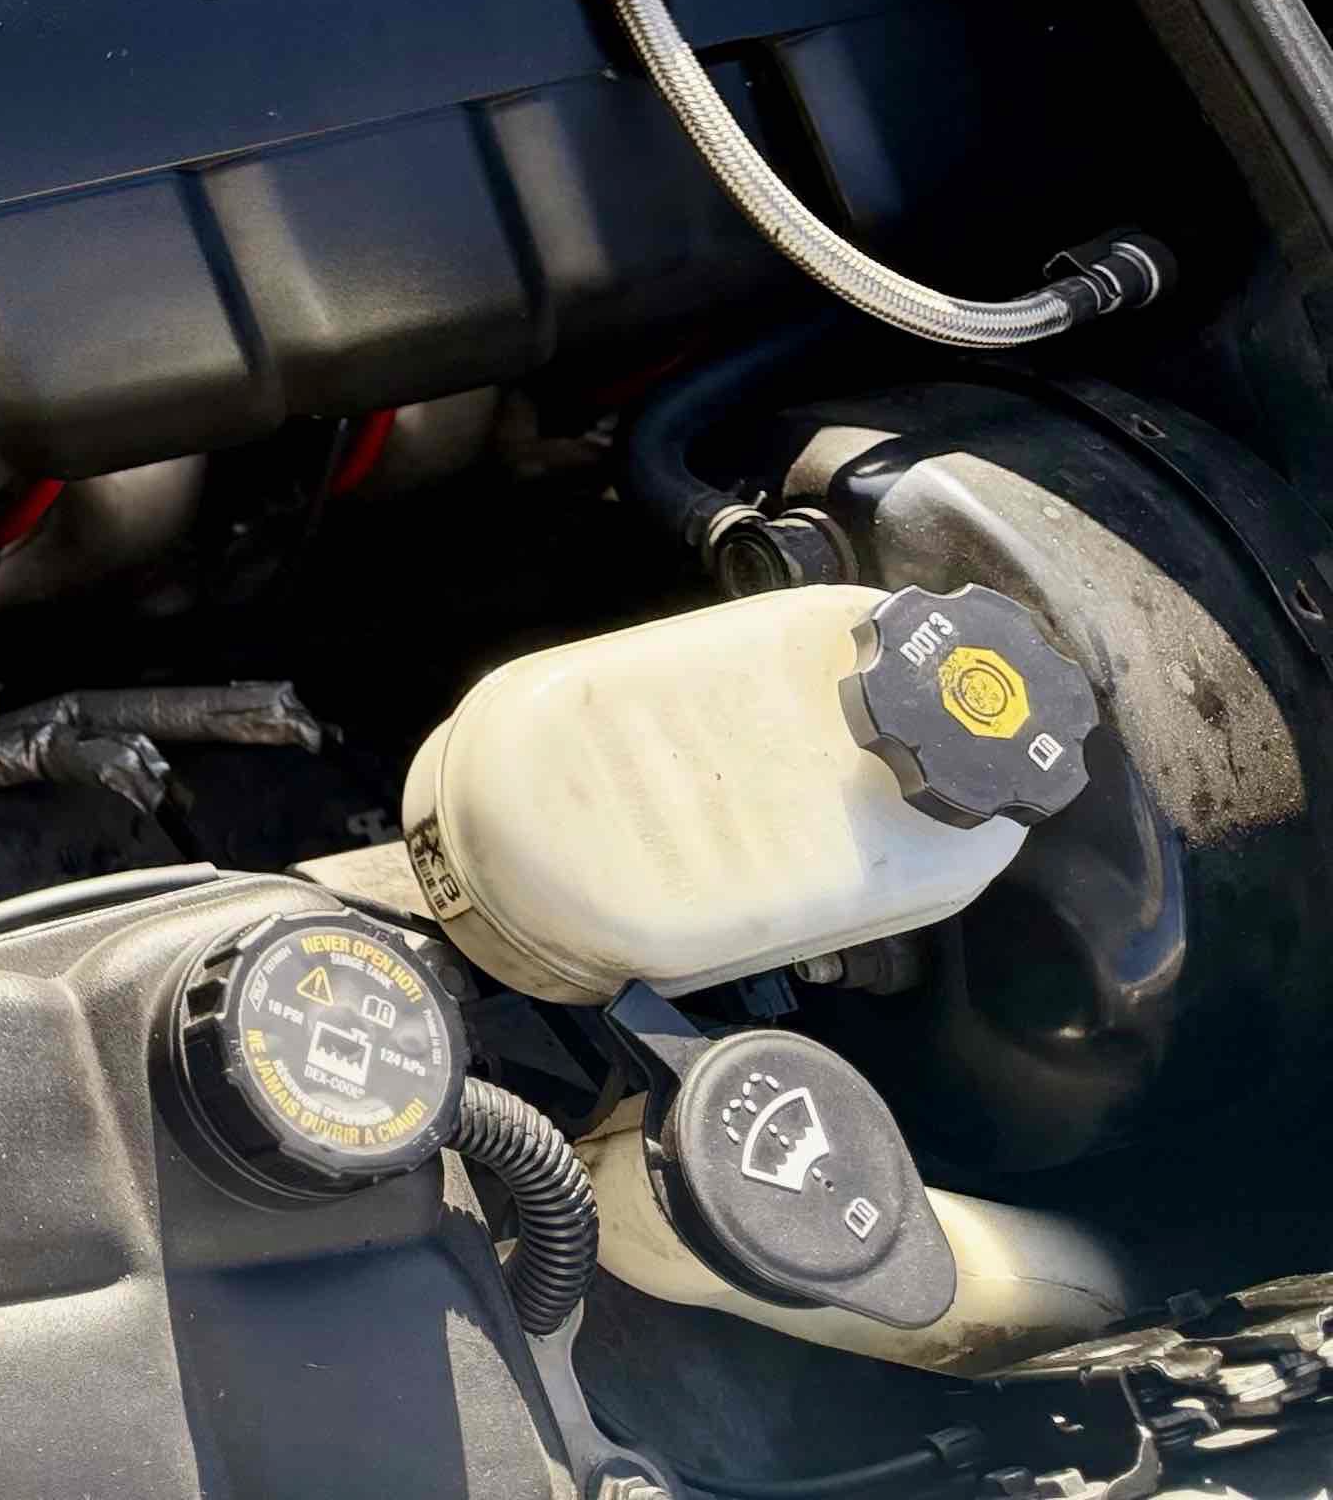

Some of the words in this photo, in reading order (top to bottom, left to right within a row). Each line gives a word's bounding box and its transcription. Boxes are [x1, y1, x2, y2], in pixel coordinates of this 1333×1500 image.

[299, 934, 351, 956] NEVER
[352, 939, 392, 971] OPEN
[388, 964, 425, 1004] HOT!
[246, 1027, 269, 1054] NE
[379, 1047, 402, 1069] 124
[402, 1053, 427, 1077] kPa
[255, 1056, 302, 1117] JAMAIS
[300, 1109, 362, 1146] OUVRIR
[376, 1096, 428, 1143] CHAUD!
